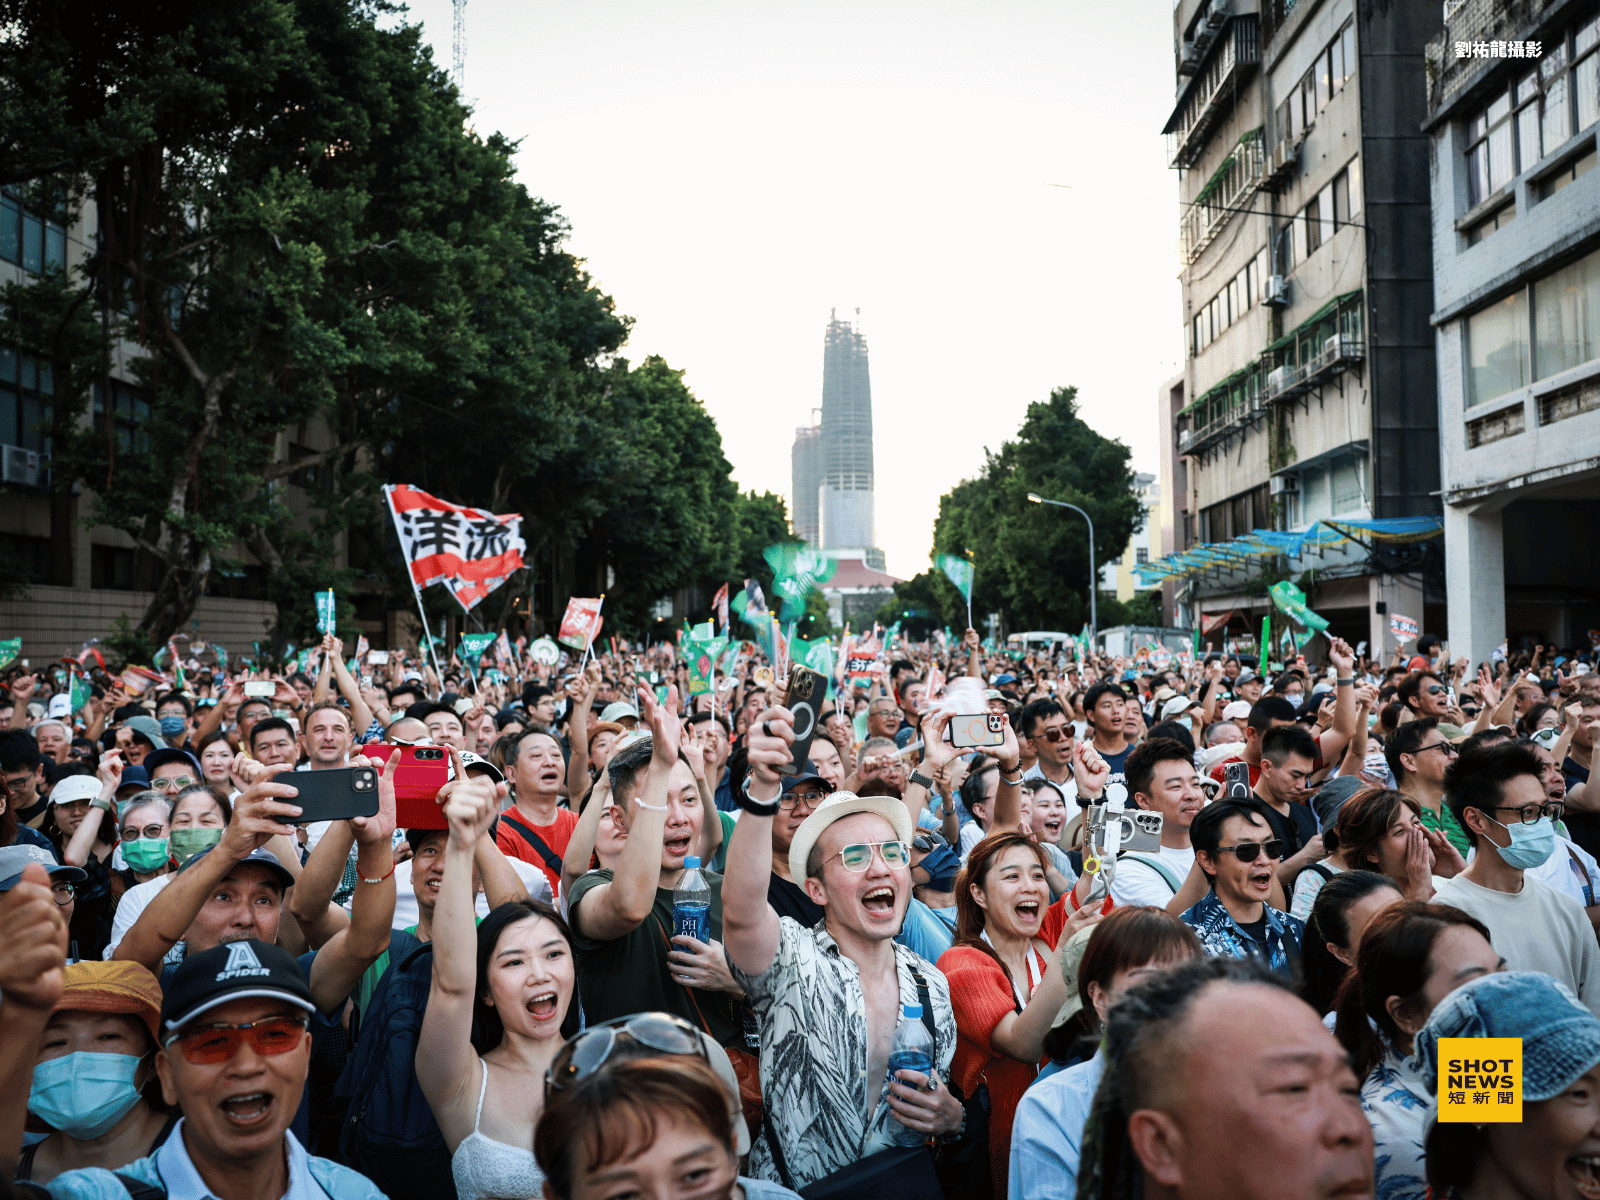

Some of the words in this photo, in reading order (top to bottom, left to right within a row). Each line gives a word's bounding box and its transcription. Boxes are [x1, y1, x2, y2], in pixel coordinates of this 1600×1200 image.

[400, 508, 511, 562] 洋流
[682, 919, 697, 930] PH
[224, 941, 263, 972] A
[215, 967, 271, 982] SPIDER
